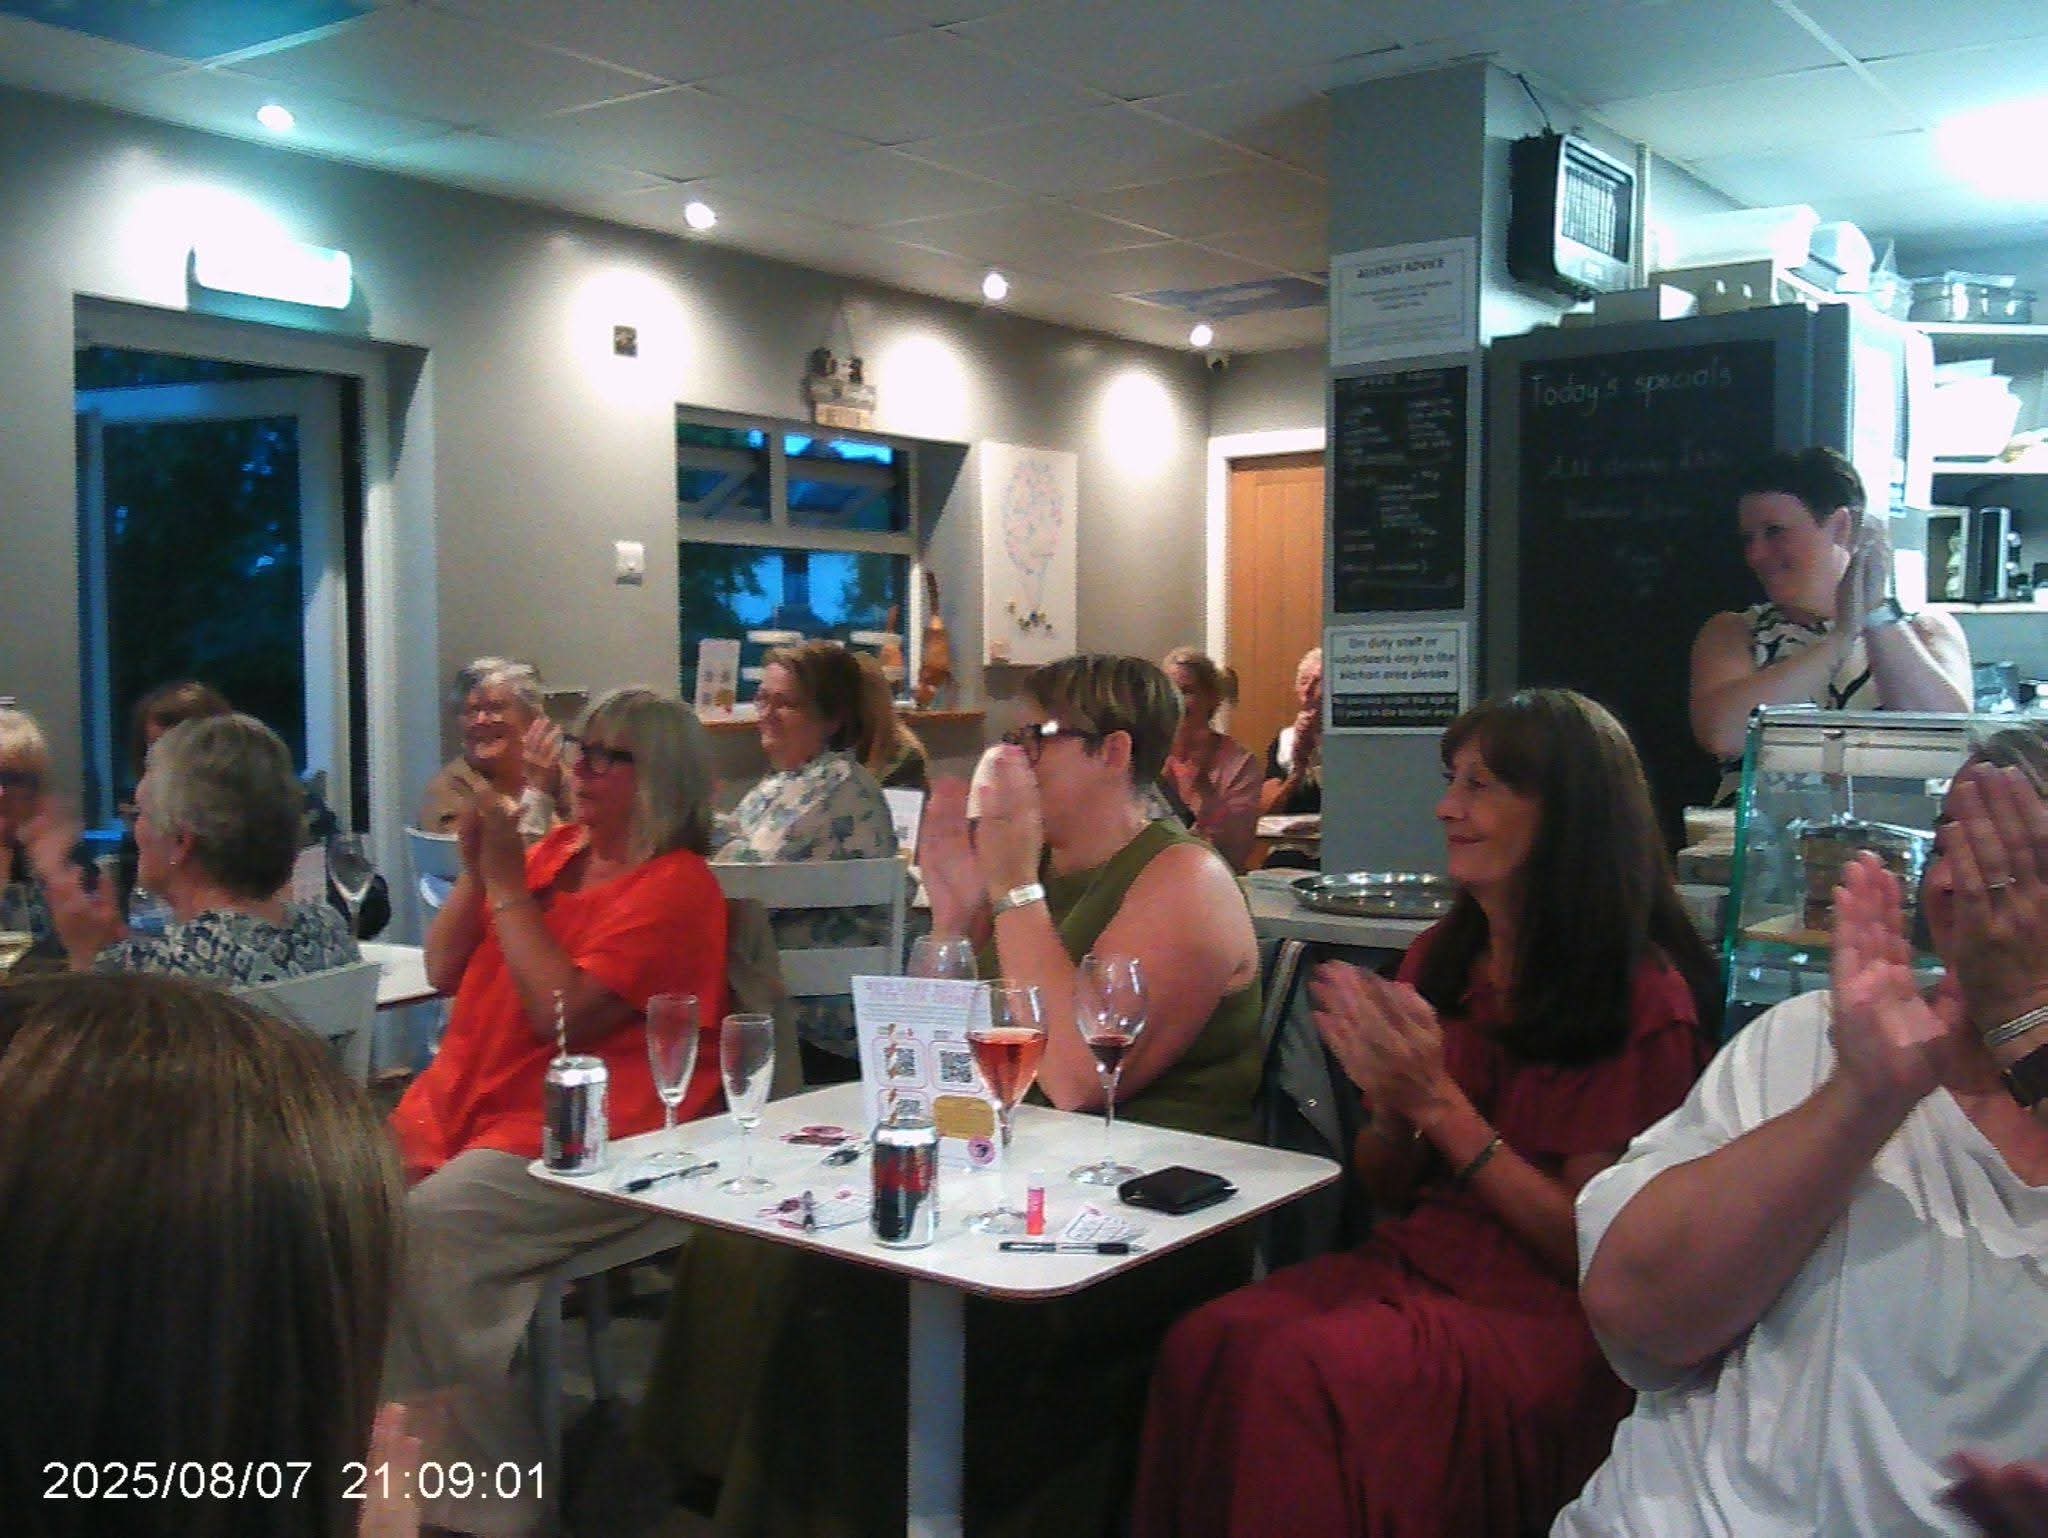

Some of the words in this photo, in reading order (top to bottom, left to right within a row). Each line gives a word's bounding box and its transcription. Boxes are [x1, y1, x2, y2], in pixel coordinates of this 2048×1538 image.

[1529, 370, 1623, 417] Today's
[1635, 355, 1734, 408] specials
[1368, 637, 1393, 650] duty
[1396, 636, 1423, 648] staff
